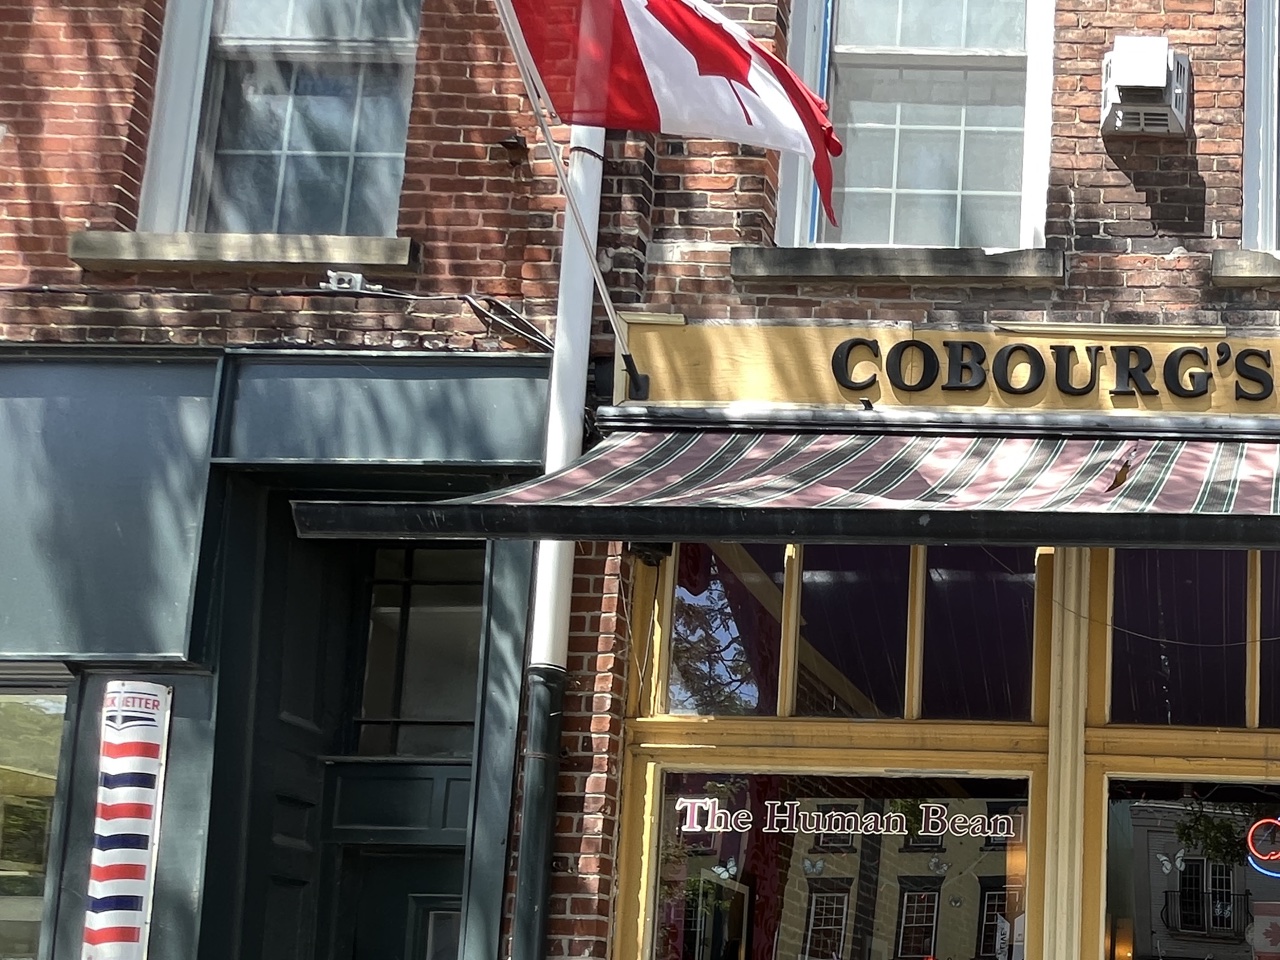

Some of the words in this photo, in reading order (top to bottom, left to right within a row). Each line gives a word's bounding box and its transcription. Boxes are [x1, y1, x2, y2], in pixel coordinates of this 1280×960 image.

[831, 337, 1273, 401] COBOURG'S
[675, 797, 753, 833] The
[762, 800, 909, 836] Human
[918, 803, 1016, 838] Bean
